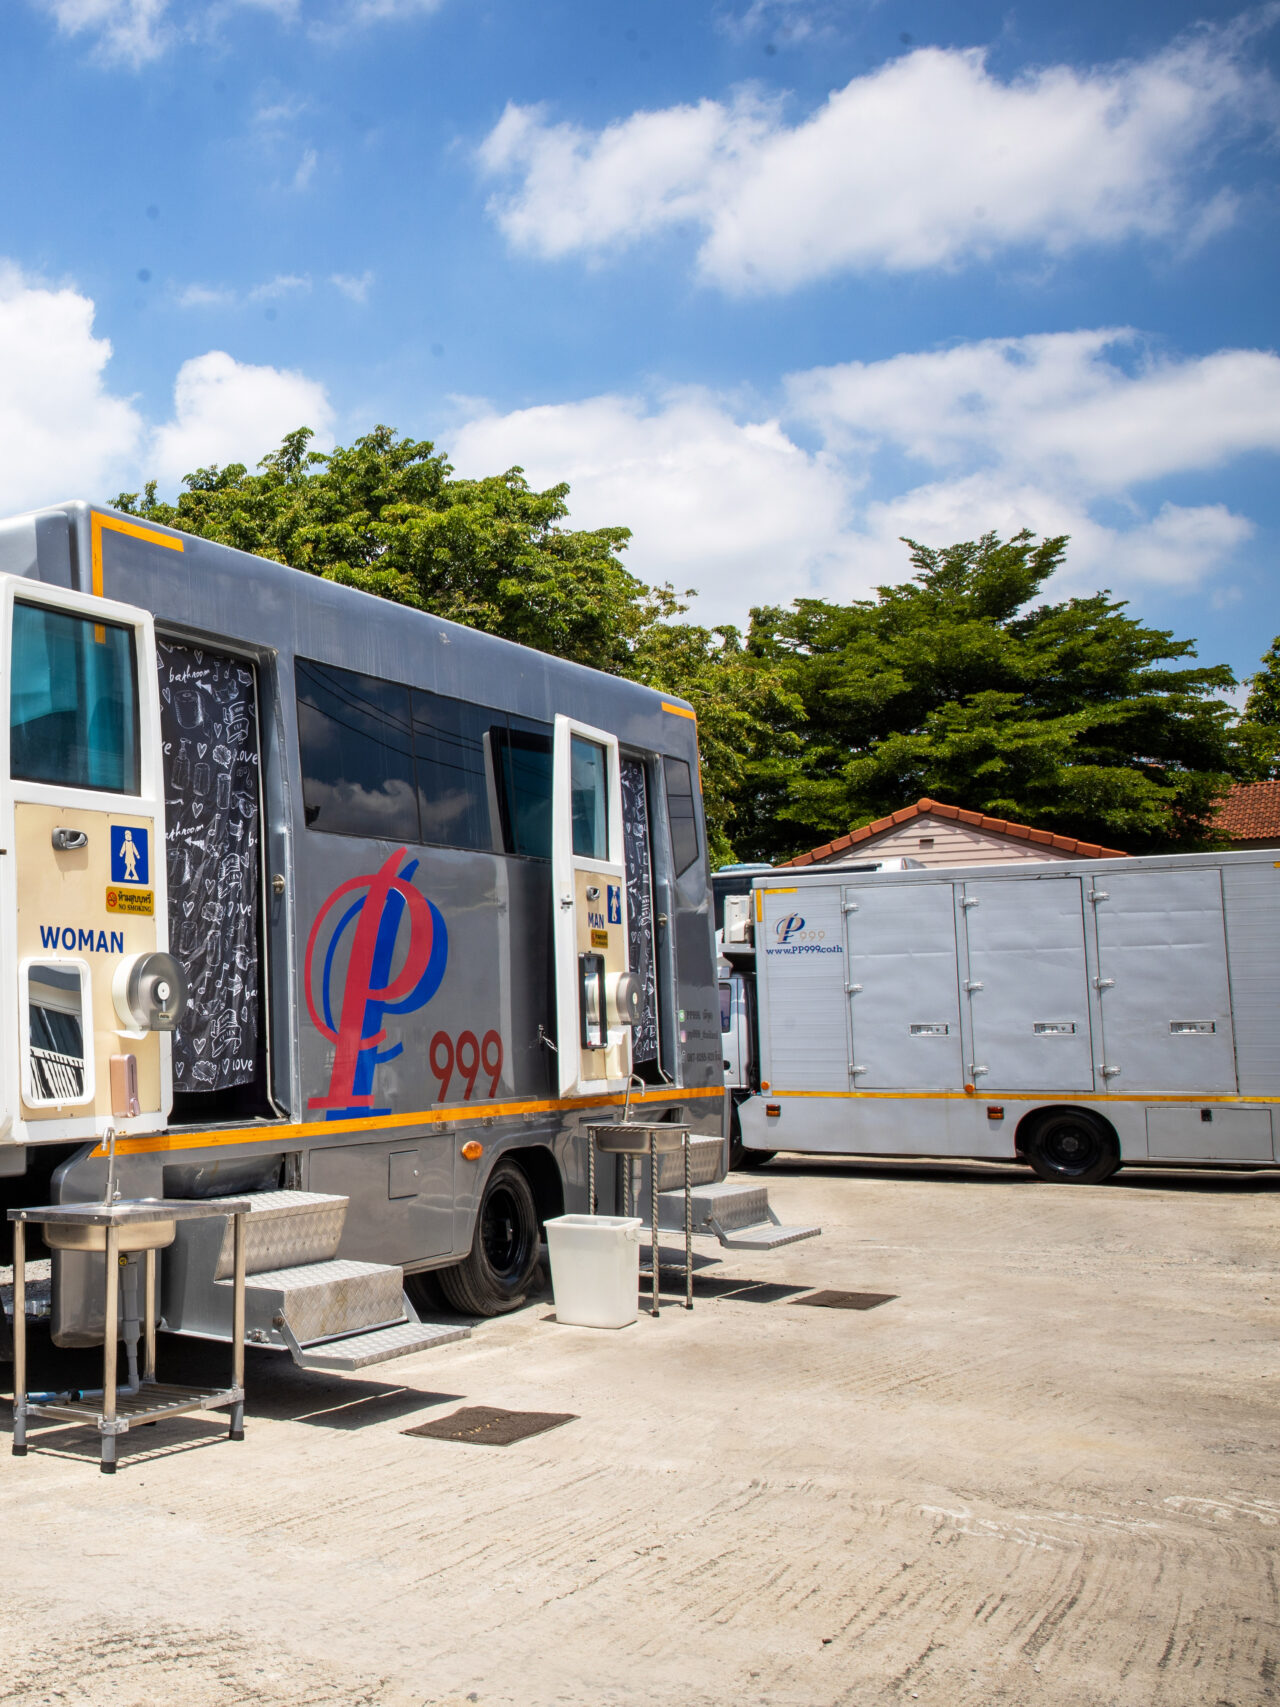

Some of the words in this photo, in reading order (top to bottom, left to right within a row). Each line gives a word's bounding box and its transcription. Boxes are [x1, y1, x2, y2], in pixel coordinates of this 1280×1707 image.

[587, 911, 604, 929] MAN
[40, 925, 124, 954] WOMAN
[800, 930, 826, 941] 999
[429, 1029, 504, 1103] 999
